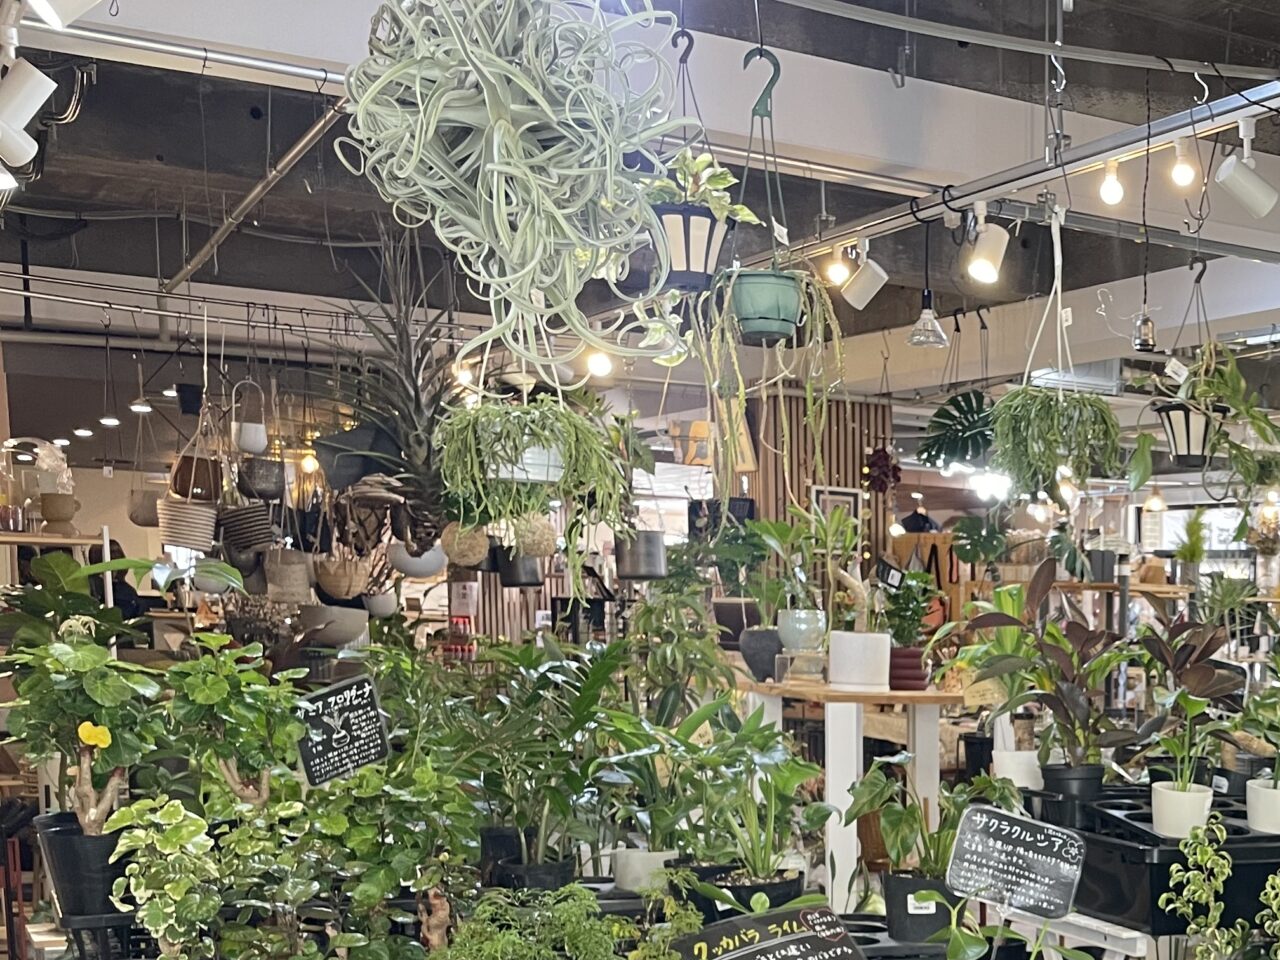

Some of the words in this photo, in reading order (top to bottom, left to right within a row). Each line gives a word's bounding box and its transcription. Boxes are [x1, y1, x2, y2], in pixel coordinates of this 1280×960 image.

[327, 682, 372, 707] フロリダーナ
[693, 928, 760, 960] クッカバラ
[768, 920, 808, 939] ライム
